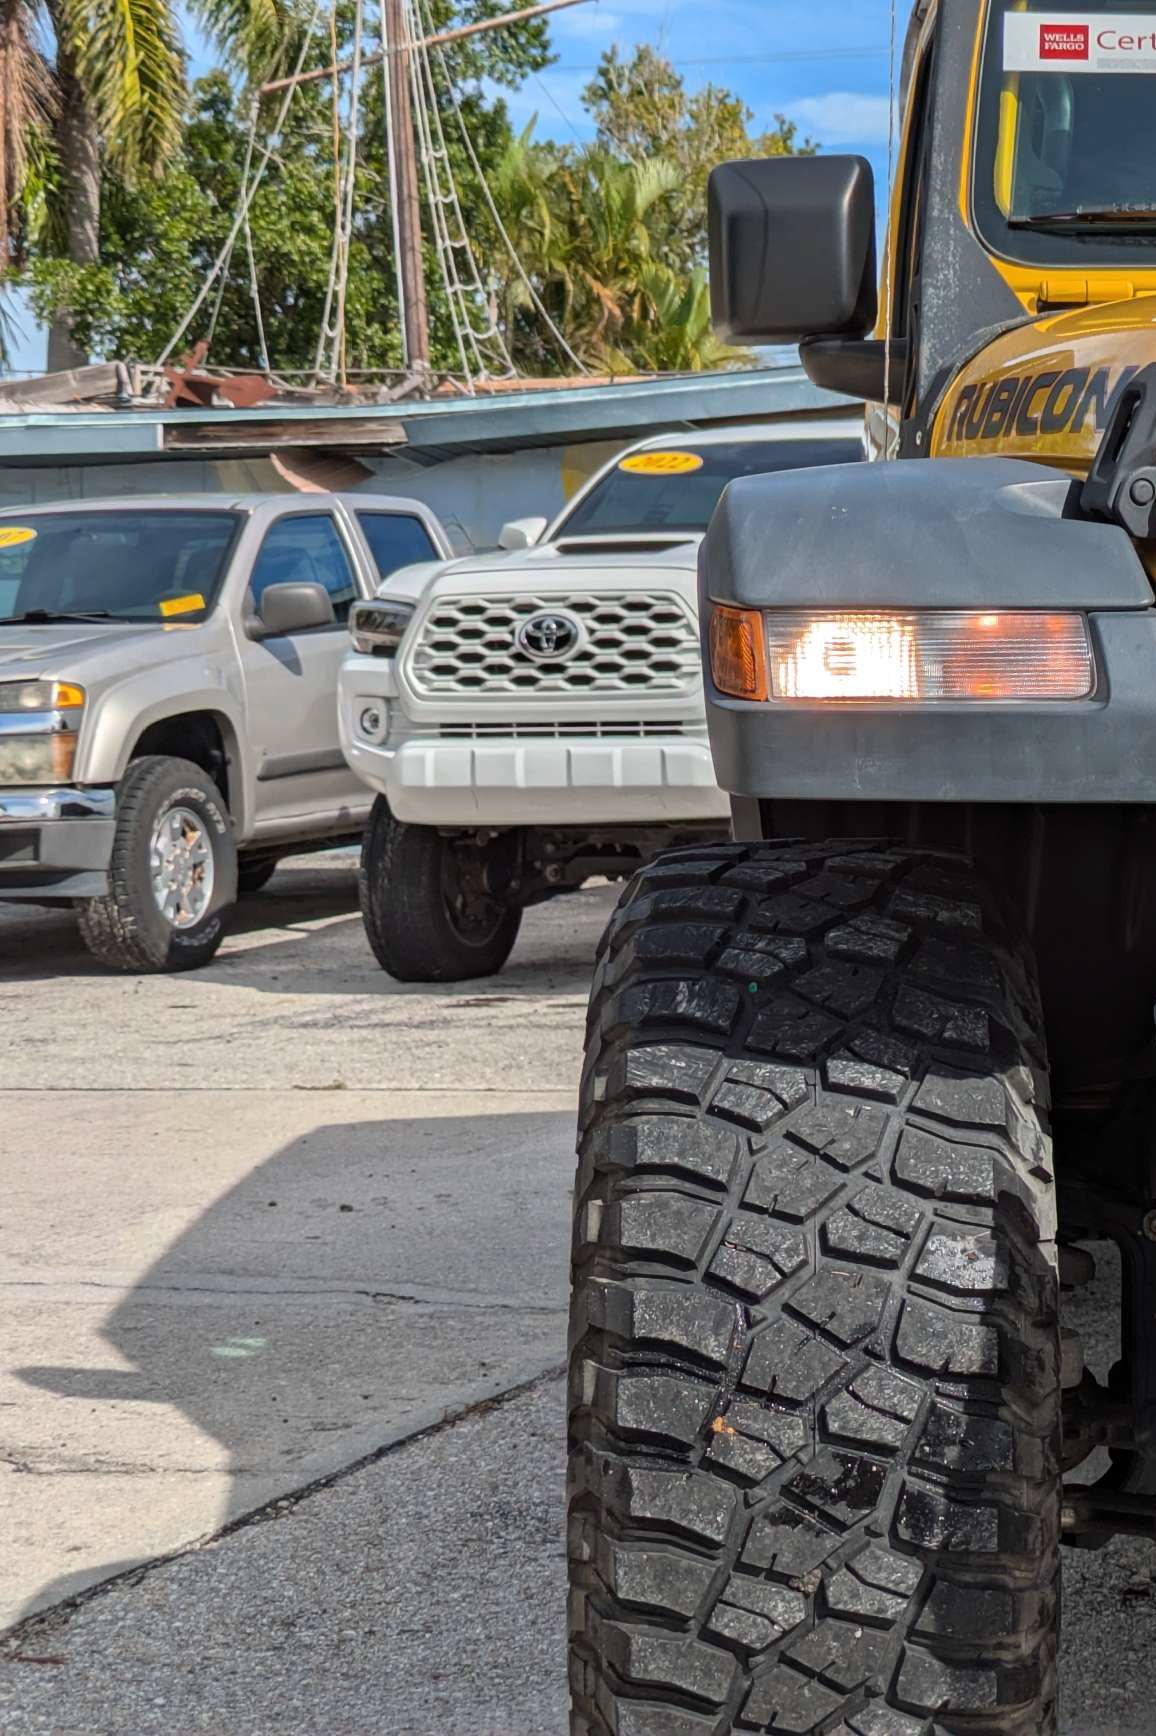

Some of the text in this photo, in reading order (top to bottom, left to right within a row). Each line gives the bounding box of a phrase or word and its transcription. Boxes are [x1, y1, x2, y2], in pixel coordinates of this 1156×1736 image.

[1043, 33, 1085, 43] WELLS
[1044, 42, 1085, 51] FARGO
[947, 364, 1141, 442] RUBICON
